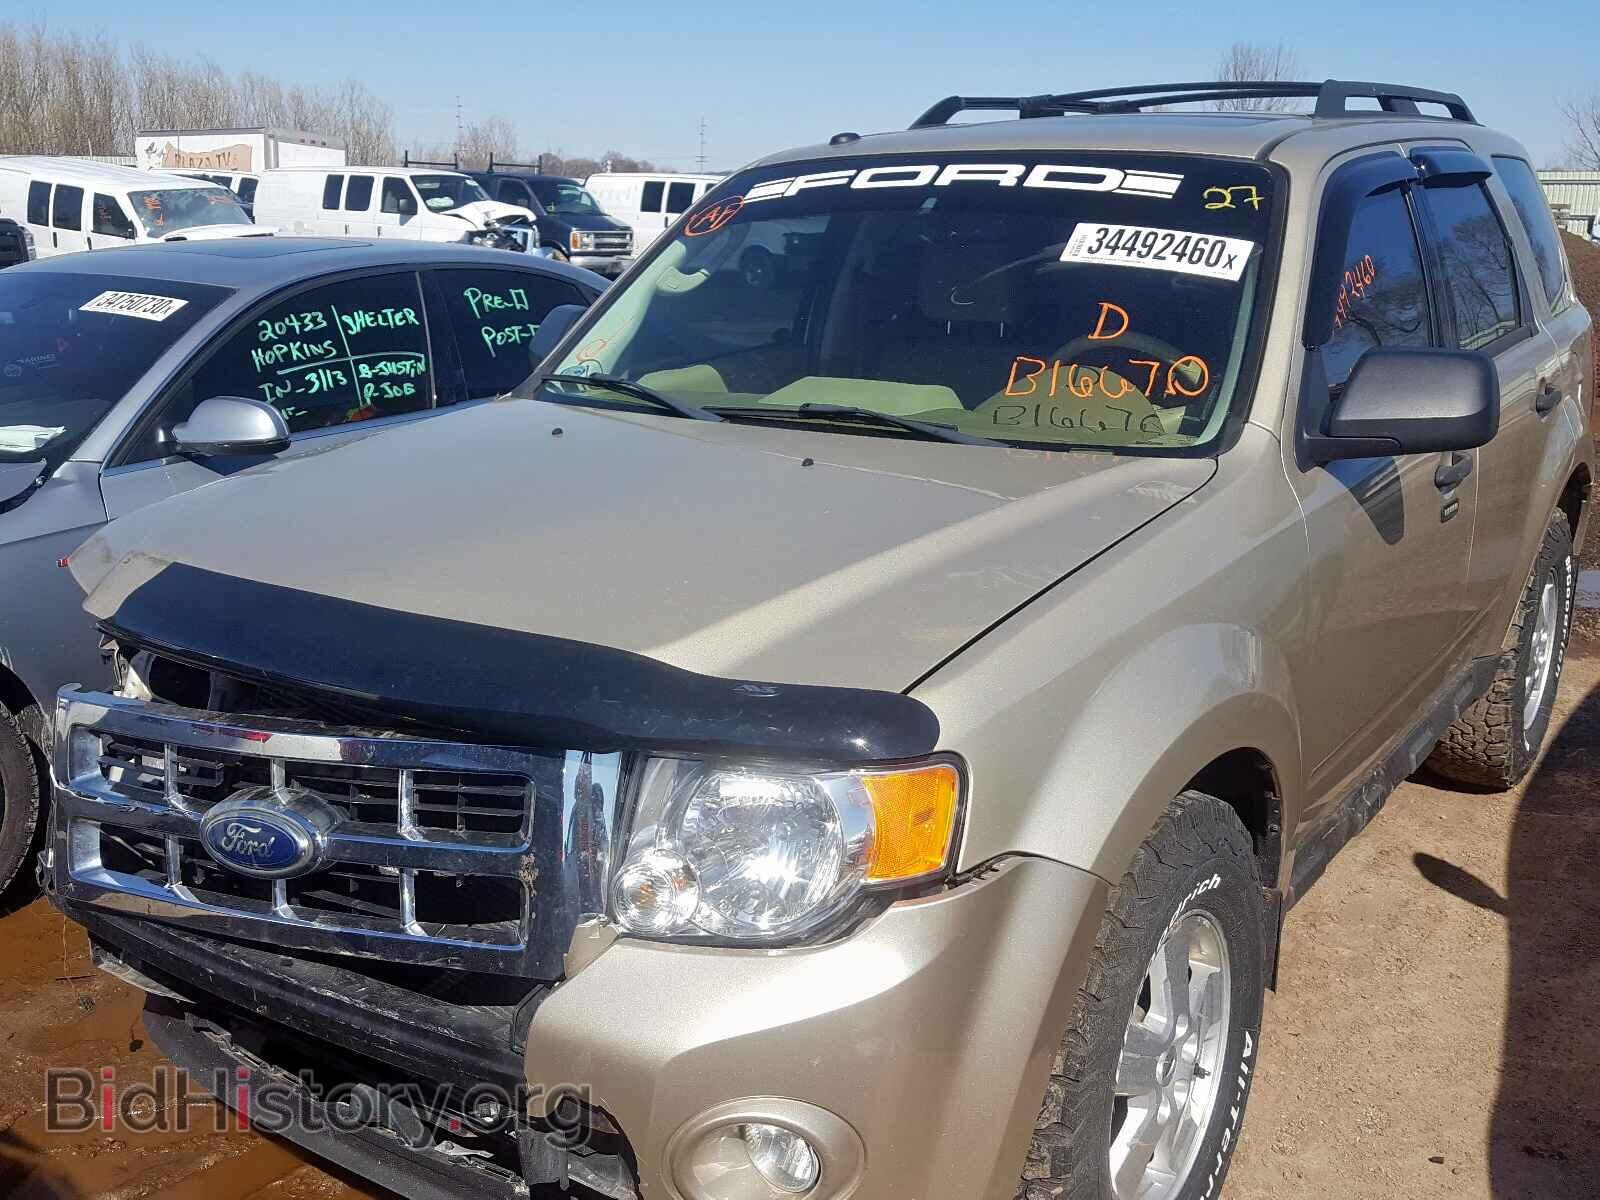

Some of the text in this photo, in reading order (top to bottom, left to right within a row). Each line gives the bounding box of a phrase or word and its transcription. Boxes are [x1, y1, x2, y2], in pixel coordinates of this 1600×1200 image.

[783, 164, 1126, 198] FORD
[1203, 186, 1264, 211] 27
[257, 311, 328, 342] 20433
[341, 307, 420, 336] SHELTER
[1088, 302, 1129, 340] D
[251, 339, 337, 373] HOPKINS
[221, 822, 275, 858] Ford
